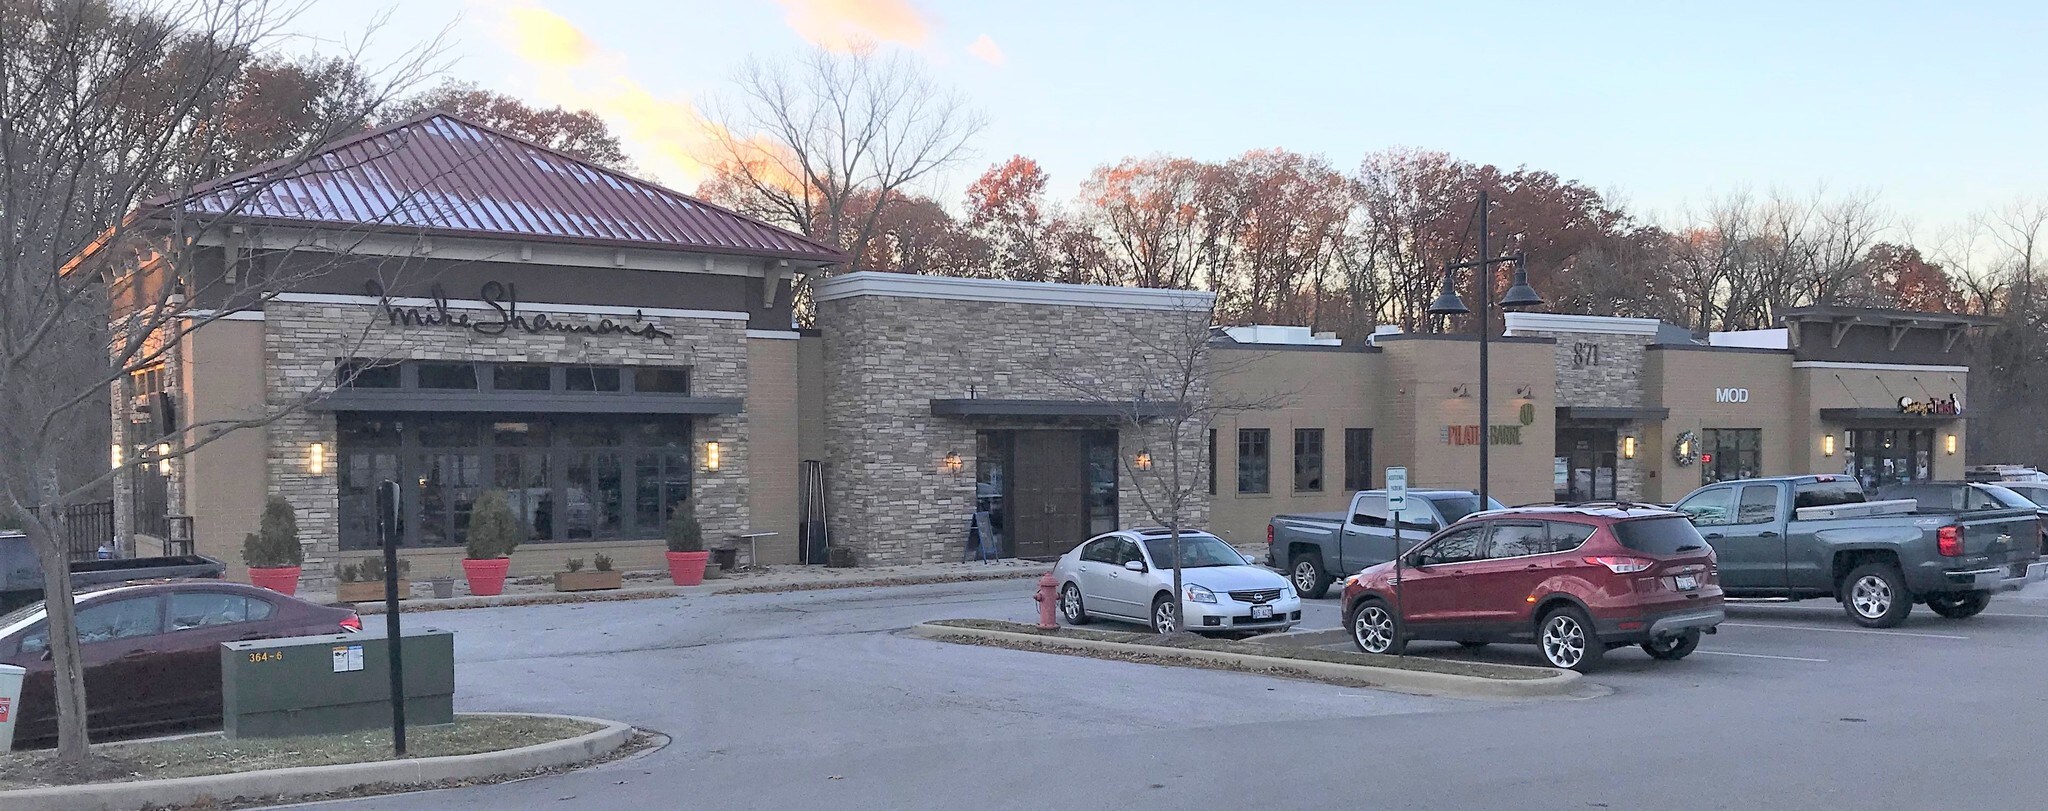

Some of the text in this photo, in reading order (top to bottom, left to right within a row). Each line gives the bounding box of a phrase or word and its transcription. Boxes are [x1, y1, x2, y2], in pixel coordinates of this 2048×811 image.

[1573, 342, 1598, 366] 871
[1715, 387, 1749, 403] MOD
[249, 651, 283, 663] 364-6
